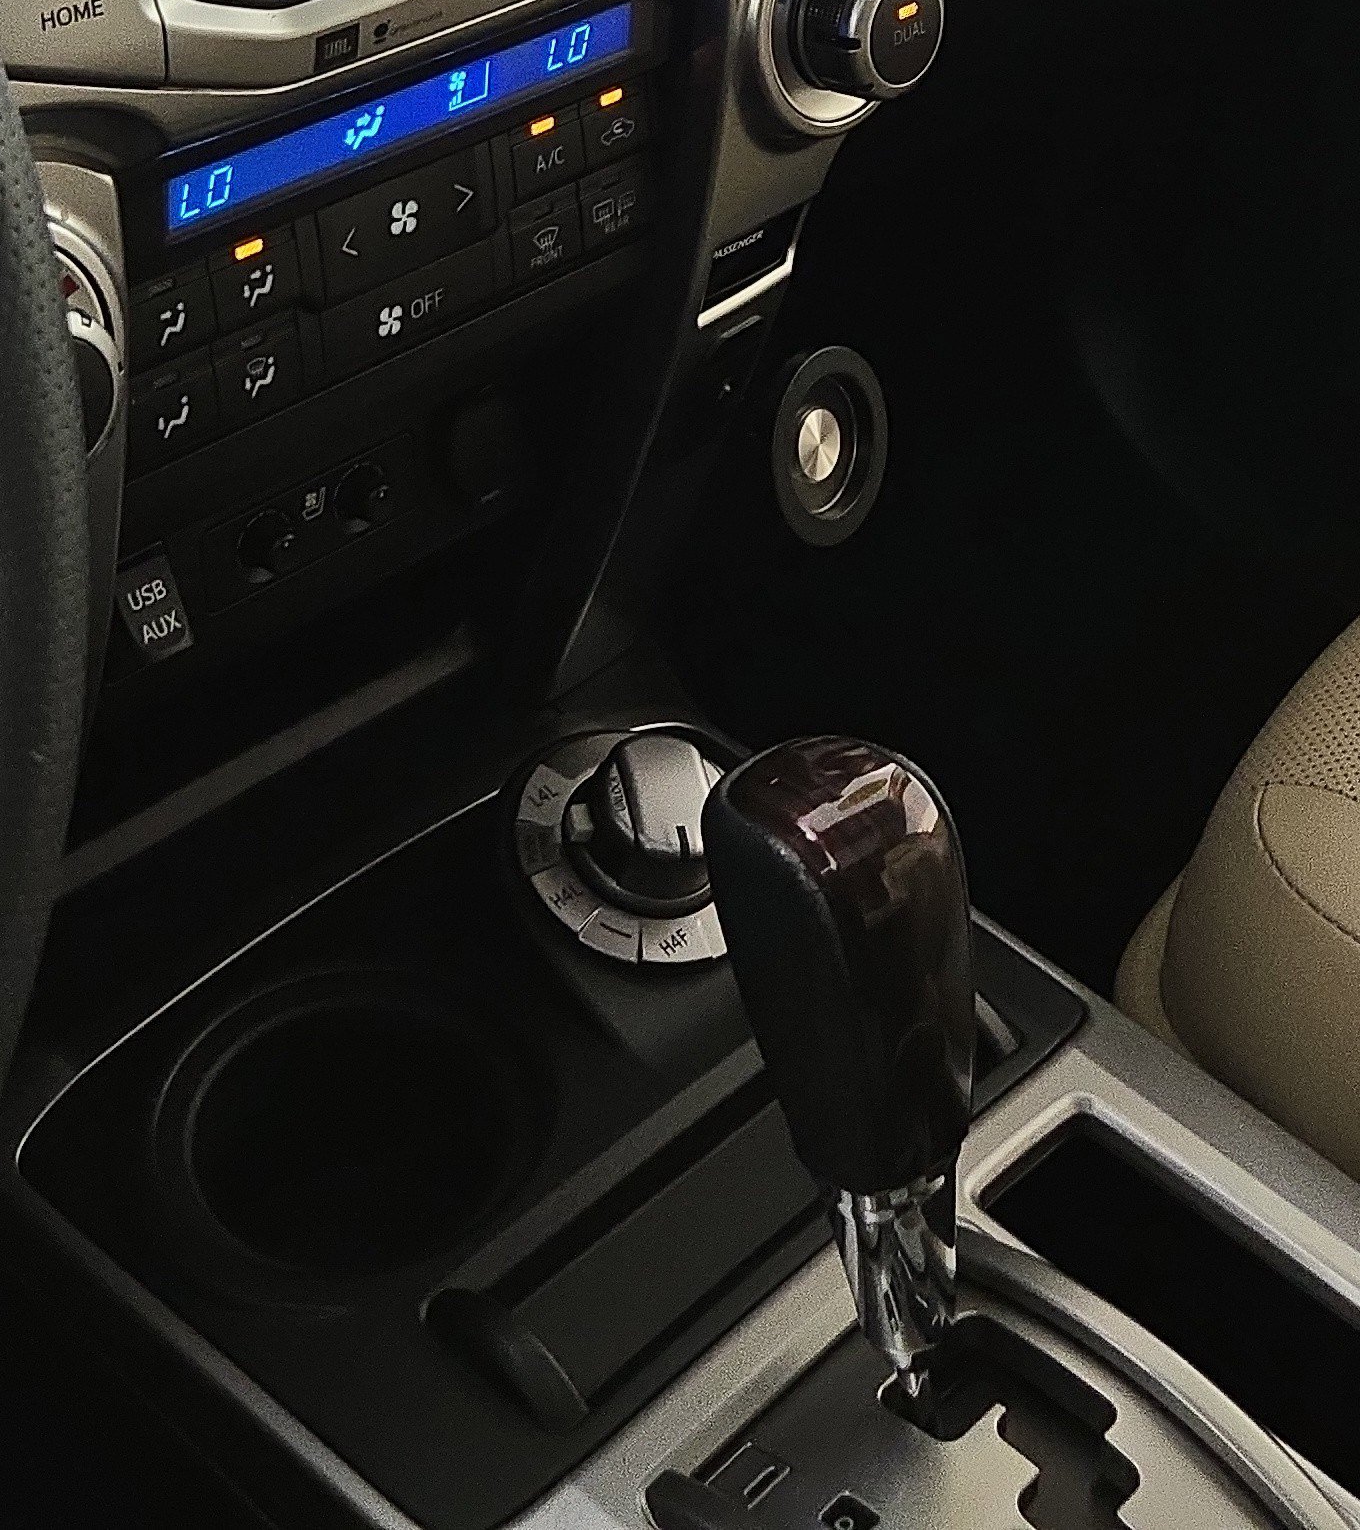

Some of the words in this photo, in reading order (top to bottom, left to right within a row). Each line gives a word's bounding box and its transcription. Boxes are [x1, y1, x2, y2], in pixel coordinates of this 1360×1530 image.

[894, 21, 926, 46] DUAL
[536, 146, 565, 173] A/C
[530, 245, 563, 268] FRONT
[408, 288, 445, 320] OFF
[127, 579, 167, 611] USB
[142, 609, 182, 644] AUX
[547, 885, 584, 911] H4L
[658, 928, 689, 958] H4F
